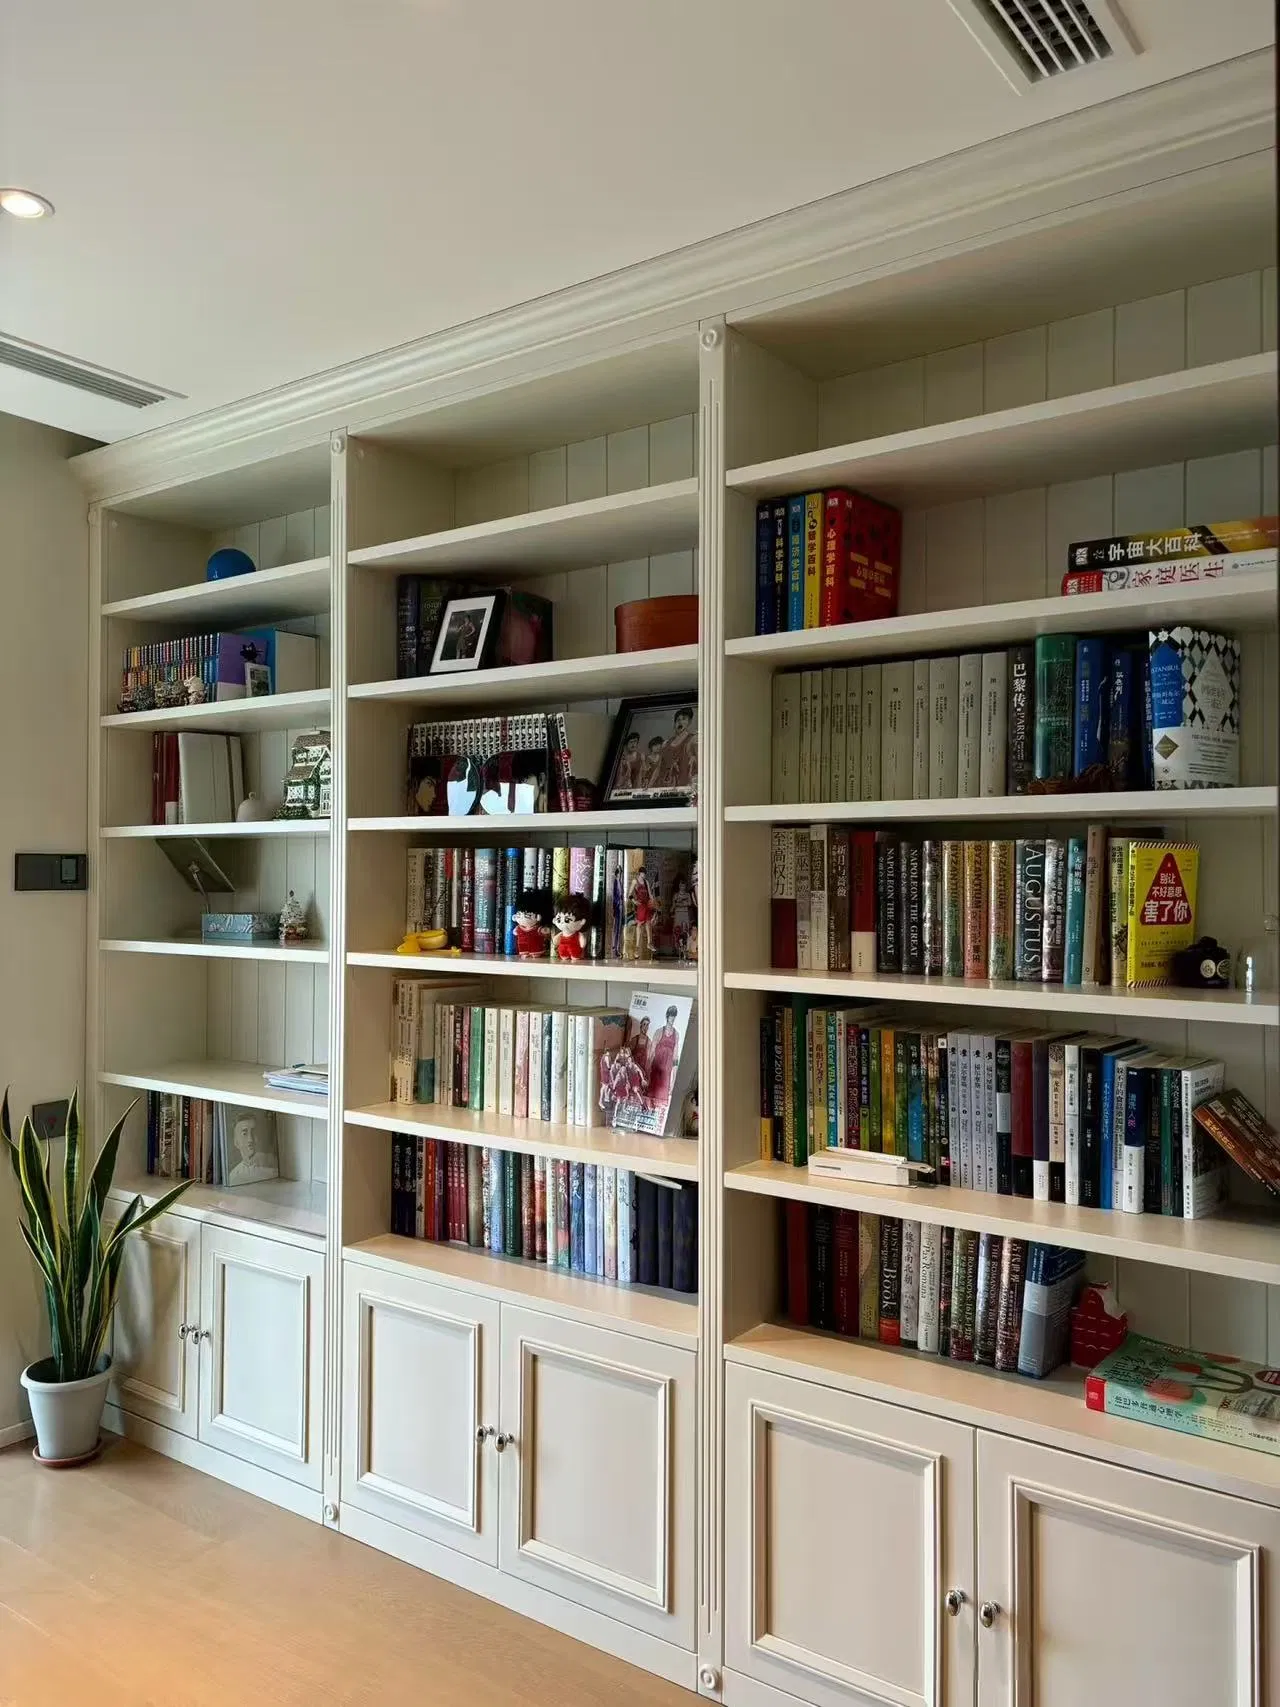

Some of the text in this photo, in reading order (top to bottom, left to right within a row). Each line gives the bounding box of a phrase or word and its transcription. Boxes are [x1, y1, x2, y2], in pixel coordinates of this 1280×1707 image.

[825, 528, 836, 588] 心理学百科
[1075, 547, 1089, 565] DK
[1108, 532, 1202, 562] 宇宙大百科
[1132, 558, 1226, 588] 家庭医生
[1013, 663, 1027, 708] 巴黎传
[557, 715, 567, 750] SLAM
[773, 831, 786, 896] 至高权力
[974, 844, 983, 909] BYZANTIUM
[1159, 872, 1176, 885] 别让
[886, 848, 895, 956] NAPOLEON THE GREAT
[910, 848, 919, 957] NAPOLEON THE GREAT
[1024, 847, 1045, 964] AUGUSTUS
[1144, 899, 1189, 923] 害了你
[1151, 885, 1183, 899] 不好意思
[991, 1243, 999, 1258] THE
[1011, 1243, 1023, 1283] 古代世界
[882, 1268, 897, 1310] Book
[920, 1261, 930, 1299] Romana
